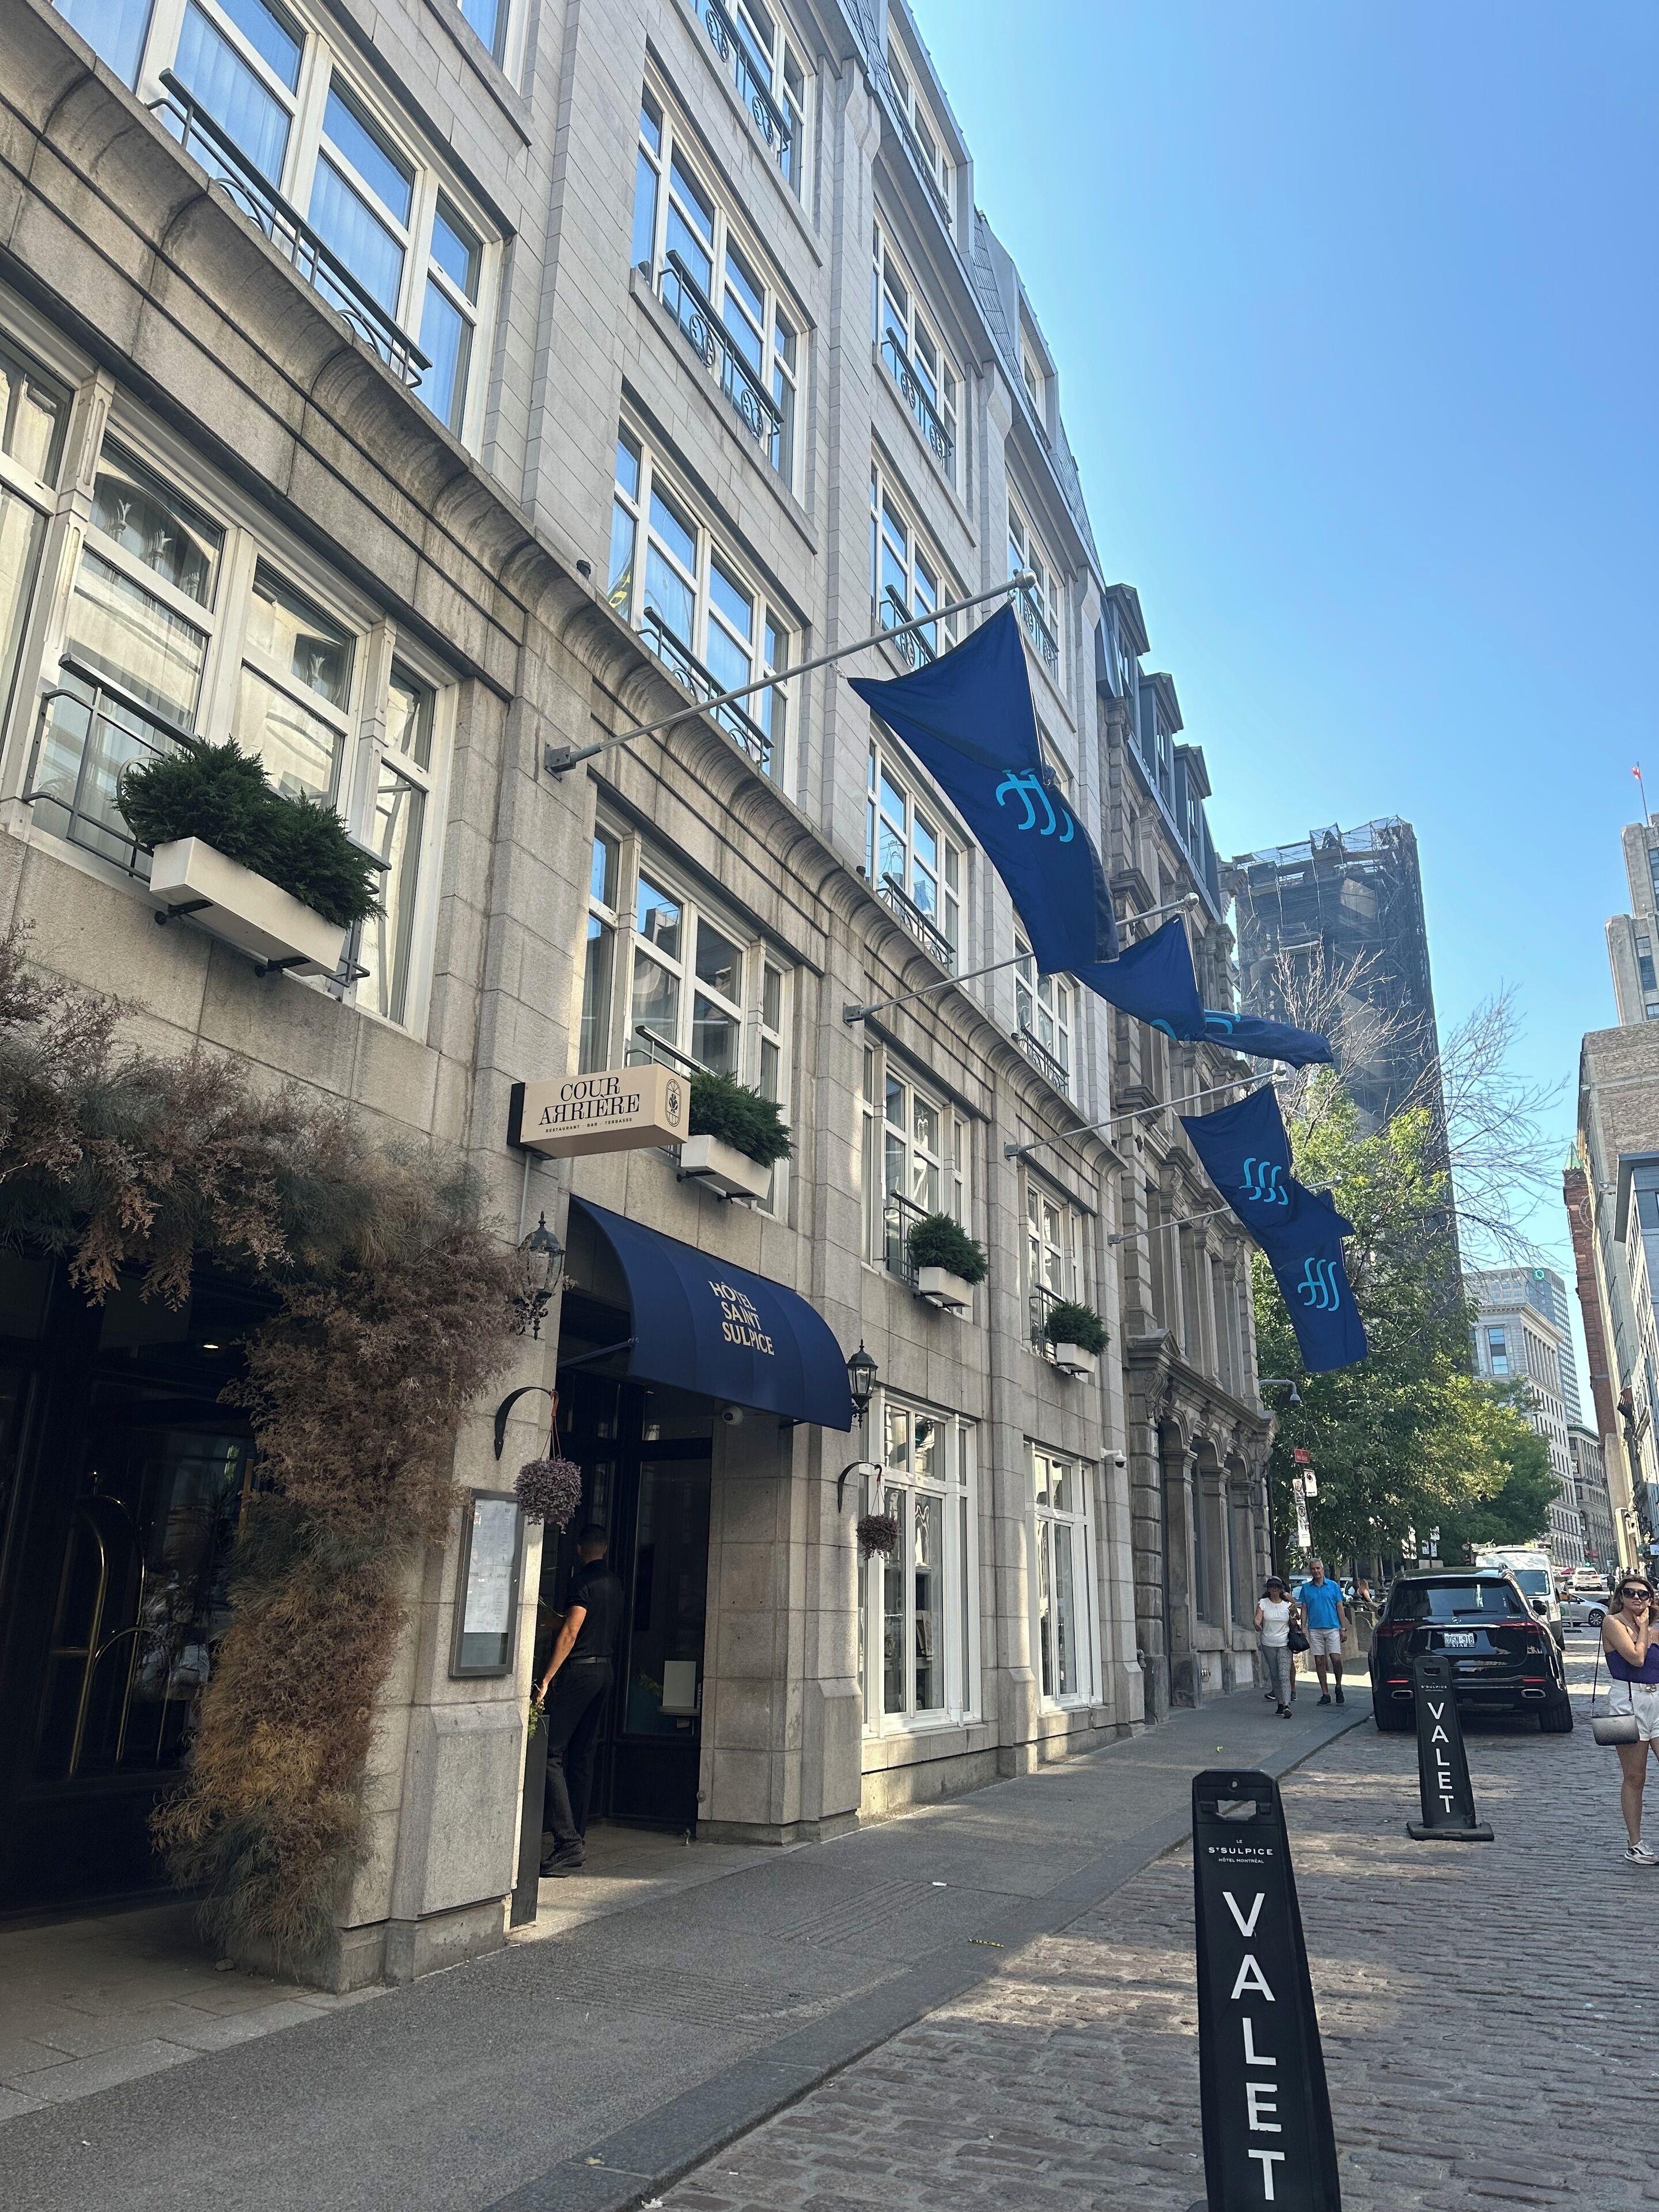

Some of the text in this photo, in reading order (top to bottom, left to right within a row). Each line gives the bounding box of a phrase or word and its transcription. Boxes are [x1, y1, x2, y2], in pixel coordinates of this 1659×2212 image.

[560, 1077, 620, 1101] COUR
[546, 1125, 579, 1133] RESTAURANT
[708, 1281, 757, 1311] HÔTEL
[721, 1301, 762, 1331] SAINT
[722, 1321, 775, 1355] SULPICE
[1427, 1702, 1455, 1813] VALET
[1222, 1891, 1285, 2201] VALET
